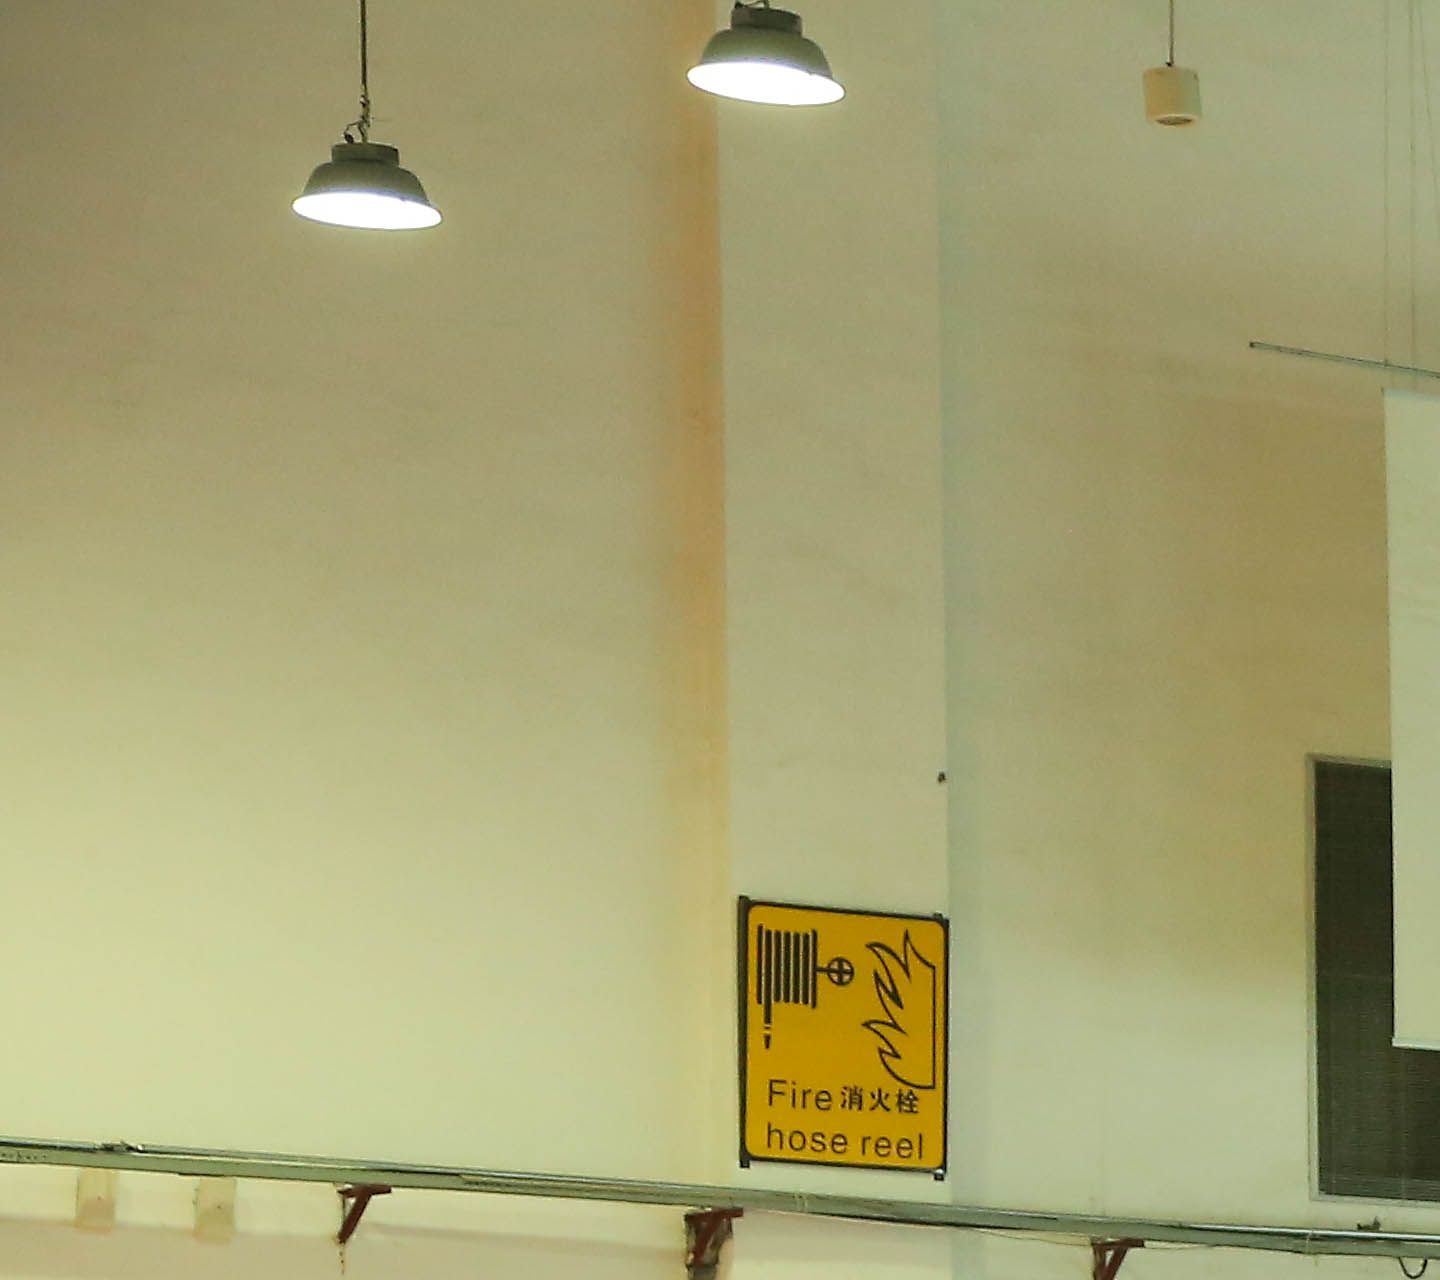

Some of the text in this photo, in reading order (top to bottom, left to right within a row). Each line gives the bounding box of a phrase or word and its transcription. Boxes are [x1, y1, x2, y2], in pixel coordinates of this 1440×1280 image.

[768, 1079, 919, 1114] Fire 消火栓
[767, 1122, 923, 1160] hose reel
